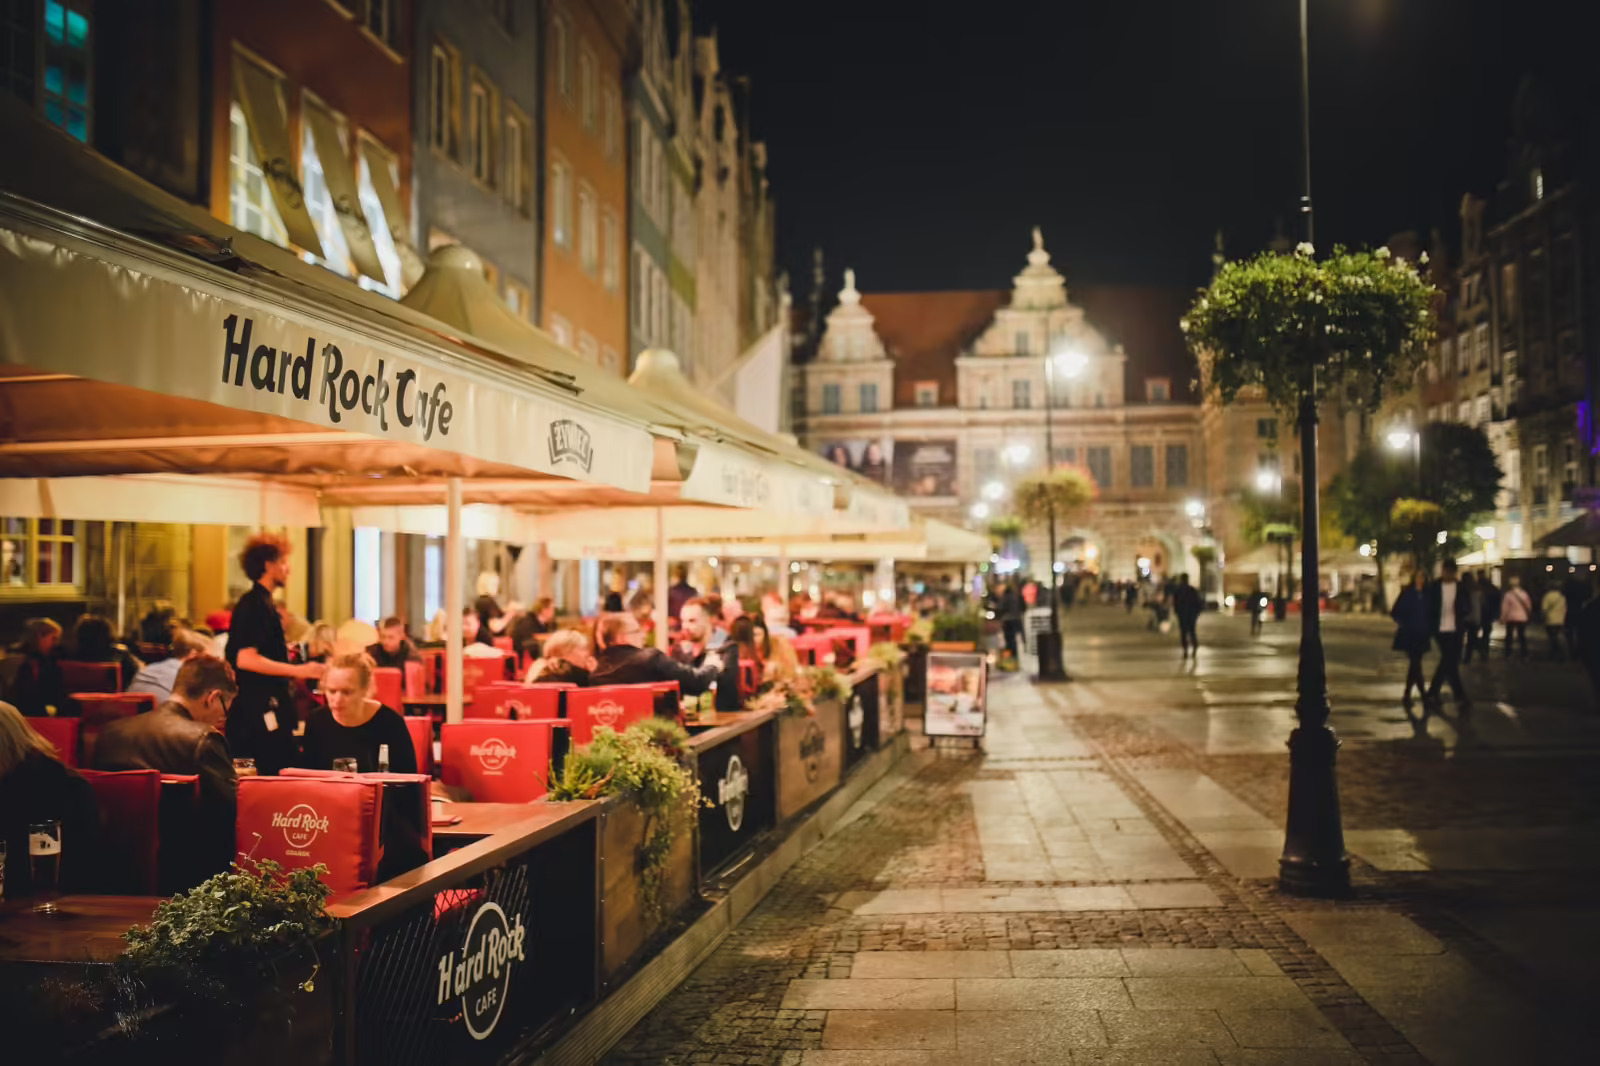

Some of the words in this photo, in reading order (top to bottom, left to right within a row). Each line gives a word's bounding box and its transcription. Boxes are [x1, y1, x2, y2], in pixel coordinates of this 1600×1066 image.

[222, 313, 316, 401] Hard
[319, 342, 389, 432] Rock
[396, 368, 453, 442] Cafe
[271, 812, 302, 828] Hard
[301, 813, 330, 833] Rock
[438, 934, 487, 1005] Hard
[487, 913, 526, 979] Rock
[475, 987, 497, 1016] CAFE
